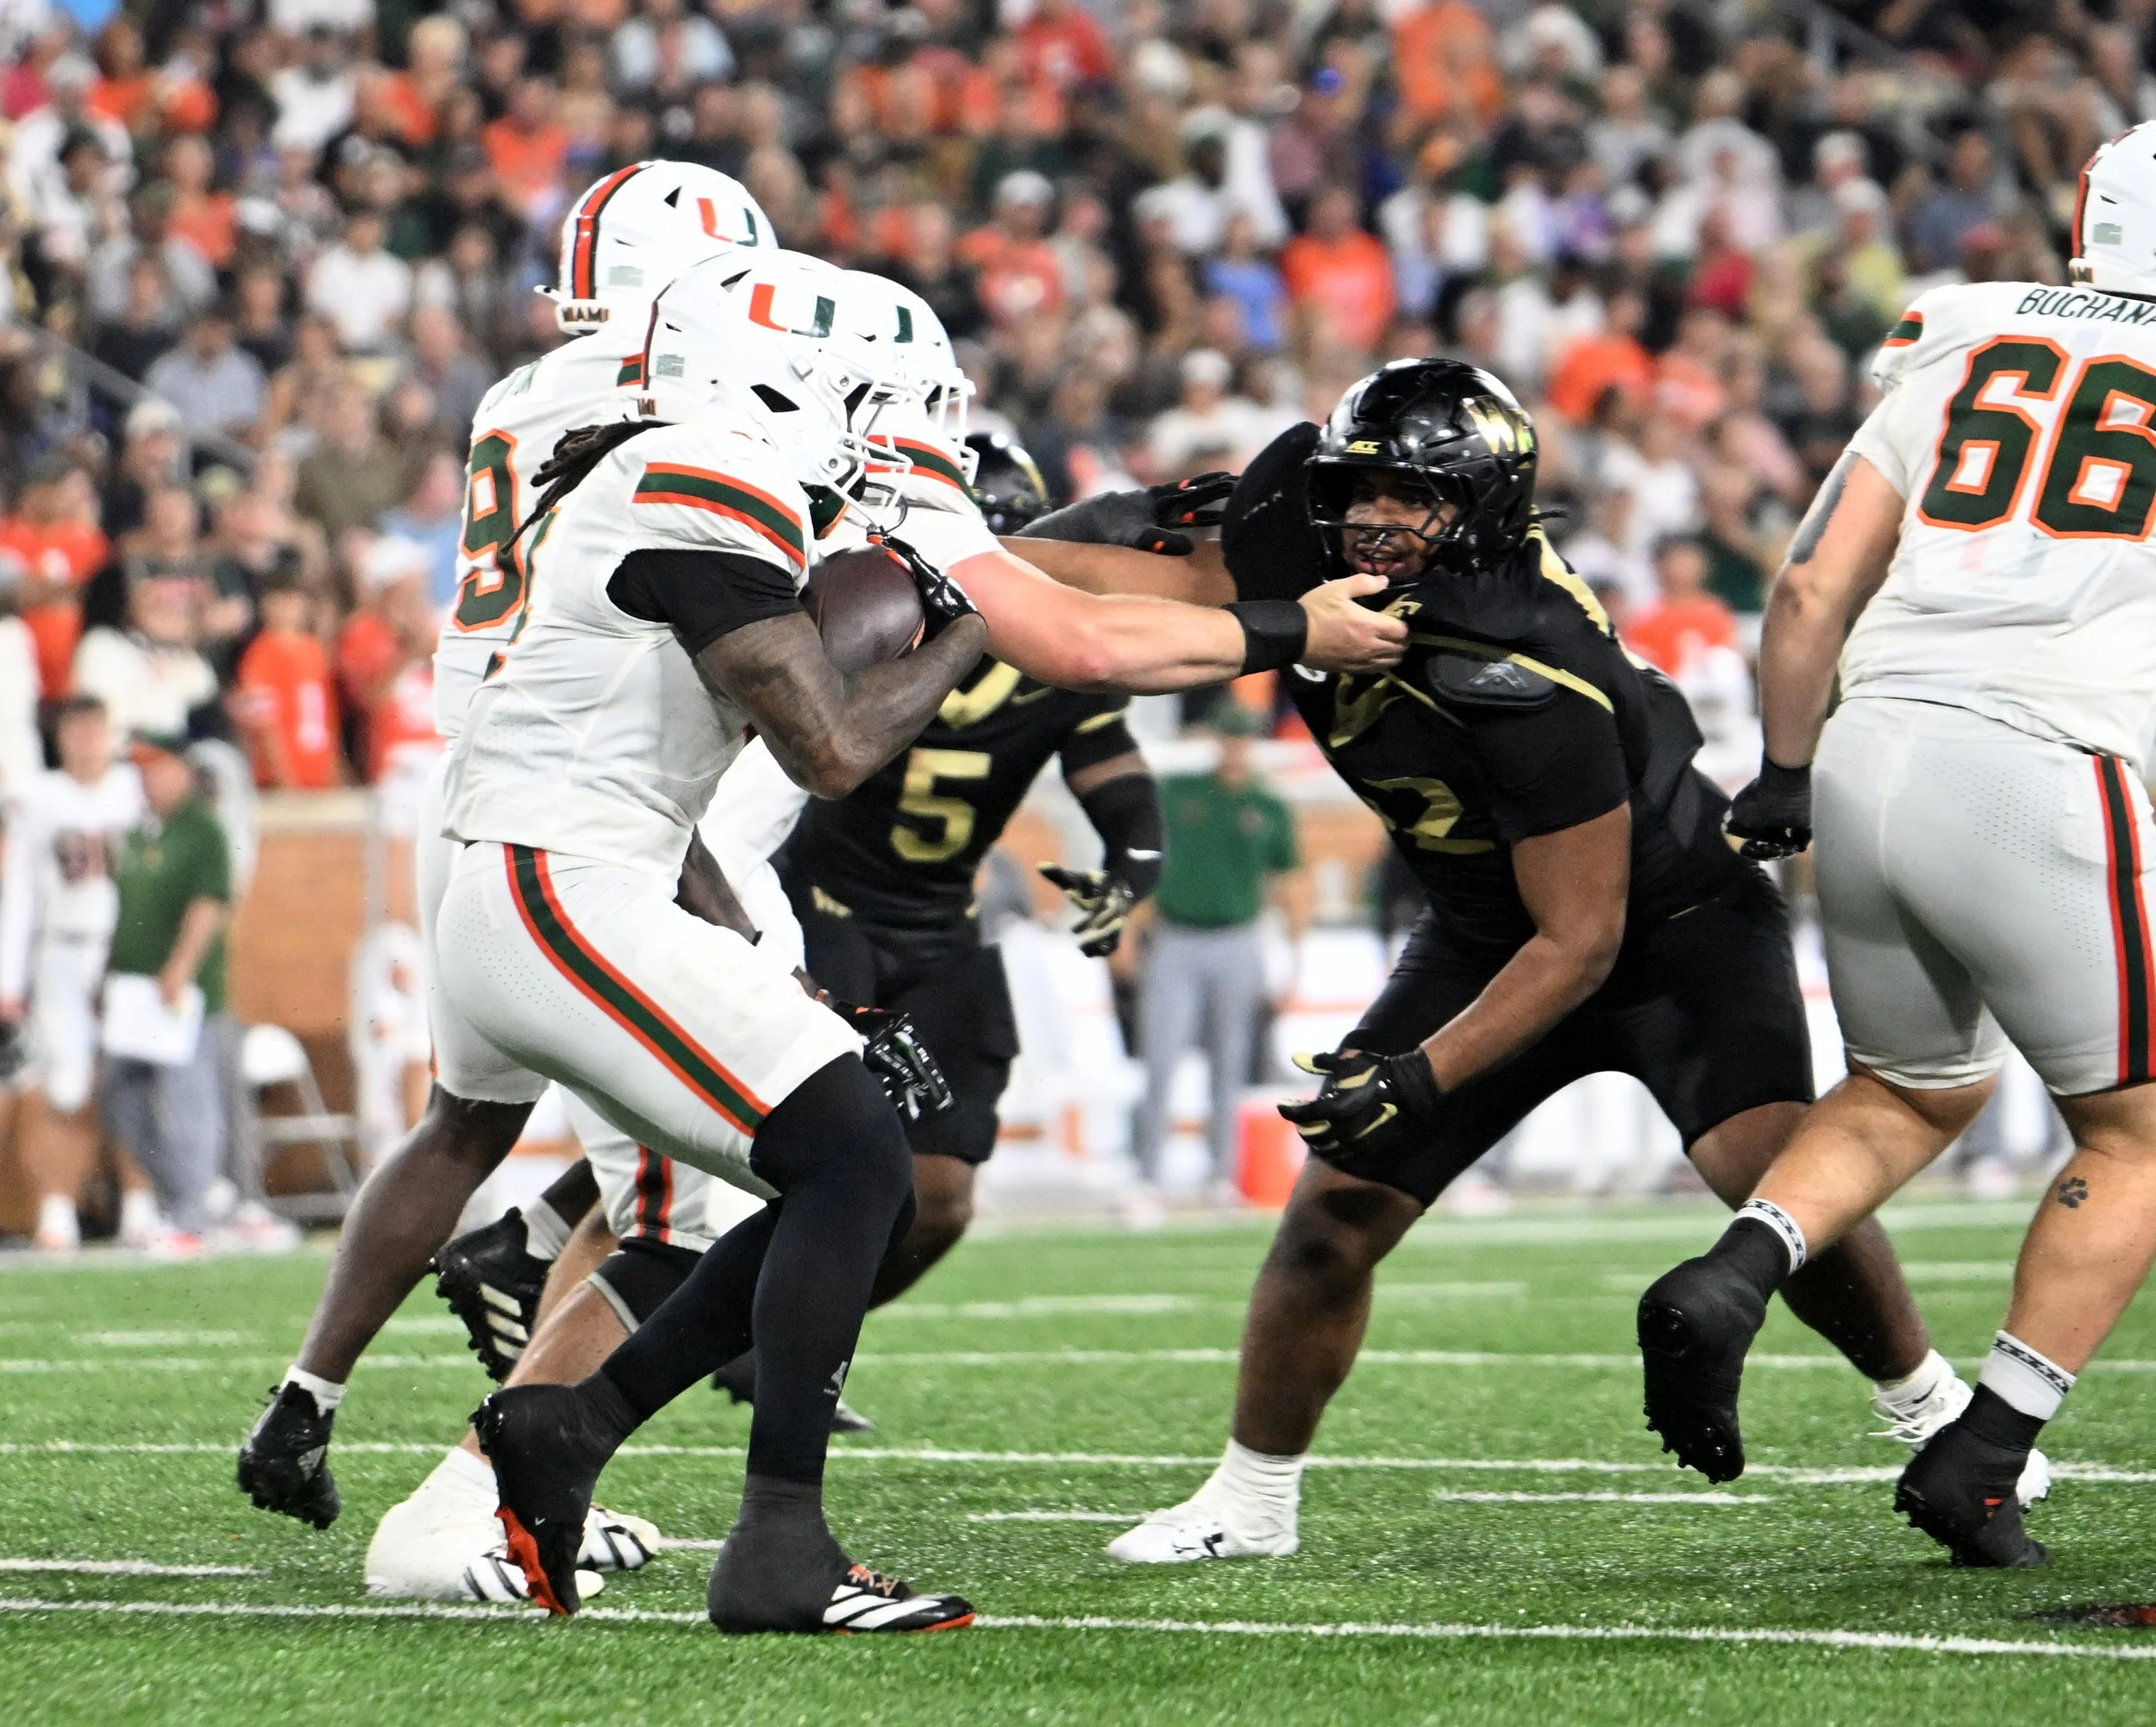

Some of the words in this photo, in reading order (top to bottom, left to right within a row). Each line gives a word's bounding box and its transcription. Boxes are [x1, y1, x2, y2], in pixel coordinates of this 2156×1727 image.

[697, 197, 758, 247] U
[749, 283, 836, 338] U
[1919, 335, 2156, 541] 66
[453, 428, 525, 633] 9
[889, 748, 993, 862] 5
